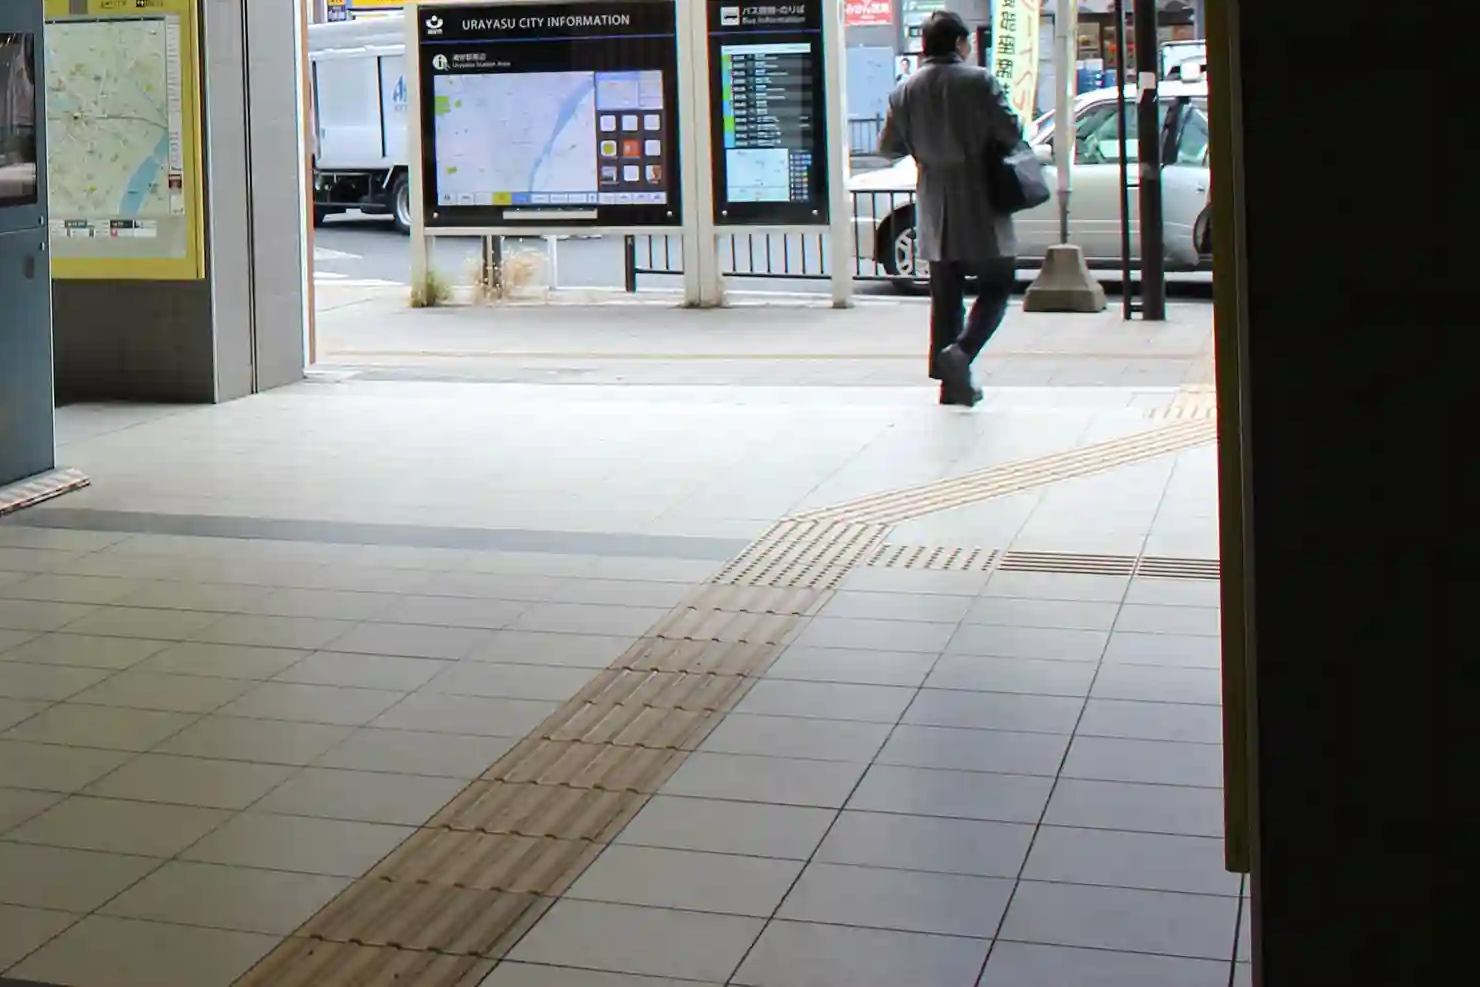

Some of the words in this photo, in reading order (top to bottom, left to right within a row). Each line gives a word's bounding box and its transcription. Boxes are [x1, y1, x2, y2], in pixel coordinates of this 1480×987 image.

[462, 17, 515, 30] URAYASU
[519, 17, 544, 28] CITY
[547, 14, 630, 28] INFORMATION
